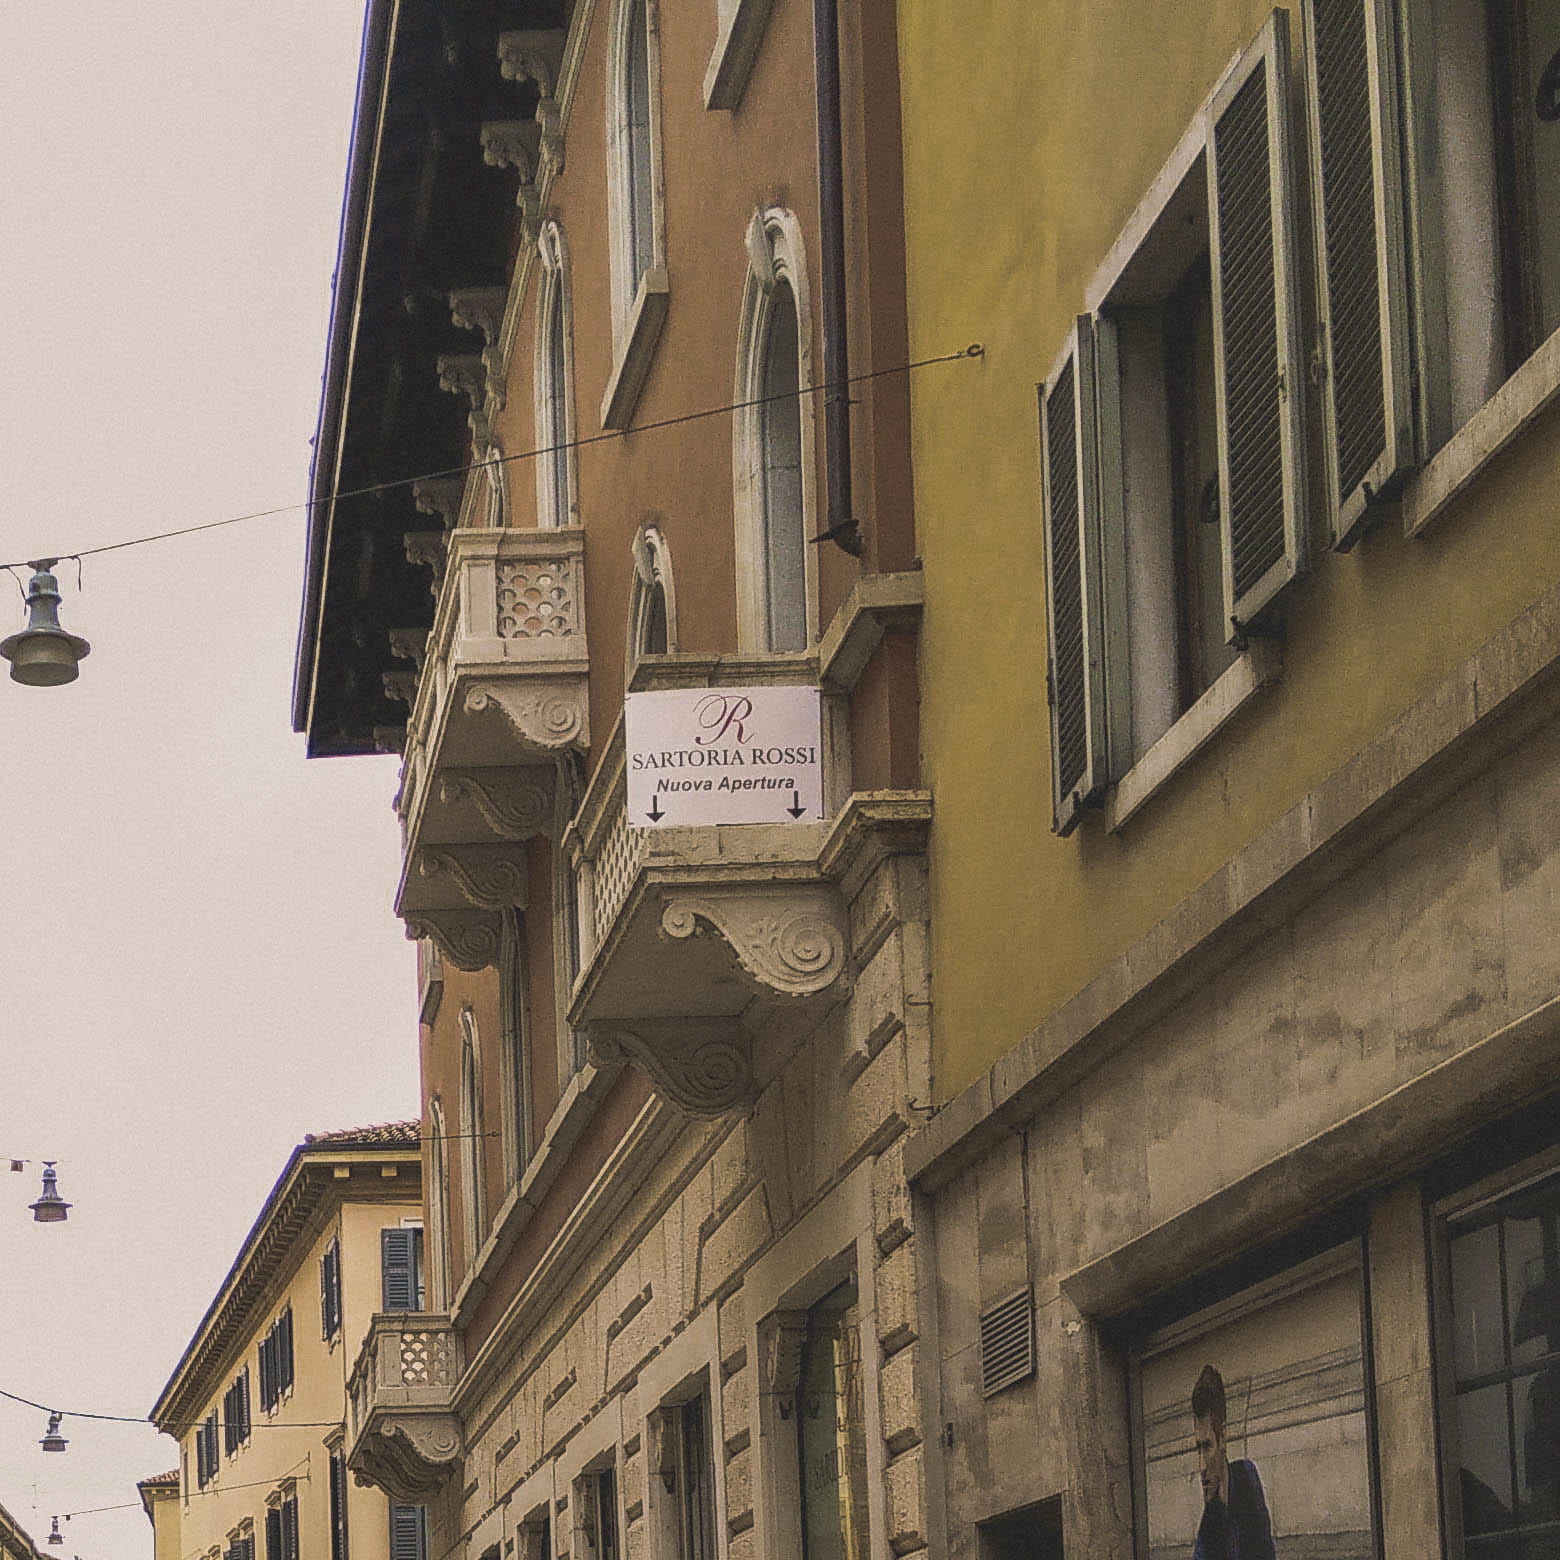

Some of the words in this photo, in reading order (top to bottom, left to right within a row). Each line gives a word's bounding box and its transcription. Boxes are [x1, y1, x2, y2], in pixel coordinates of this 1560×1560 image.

[632, 749, 744, 770] SARTORIA
[751, 747, 817, 766] ROSSI
[656, 778, 713, 793] Nuova
[717, 776, 795, 793] Apertura
